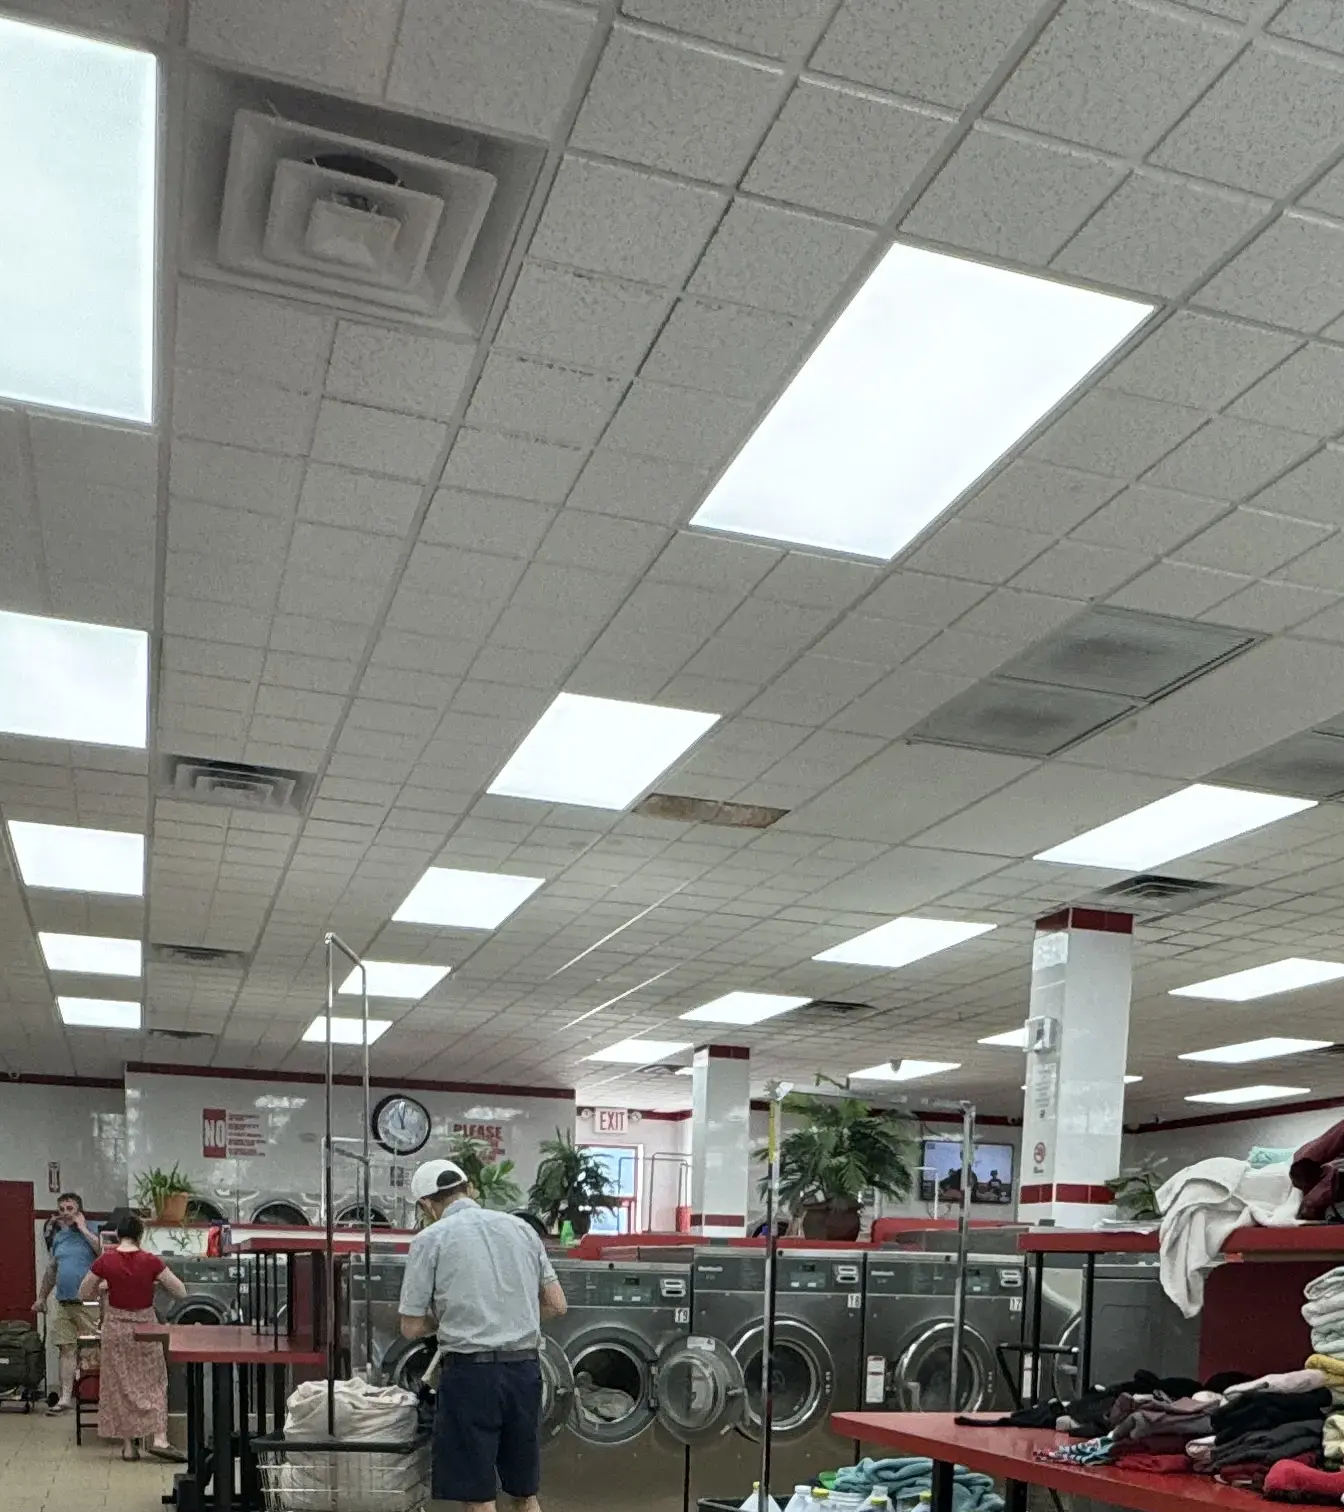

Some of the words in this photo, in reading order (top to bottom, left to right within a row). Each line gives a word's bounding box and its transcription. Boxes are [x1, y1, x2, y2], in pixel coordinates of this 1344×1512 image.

[600, 1111, 625, 1130] EXIT
[204, 1119, 226, 1149] NO
[454, 1124, 502, 1139] PLEASE
[676, 1308, 689, 1323] 19
